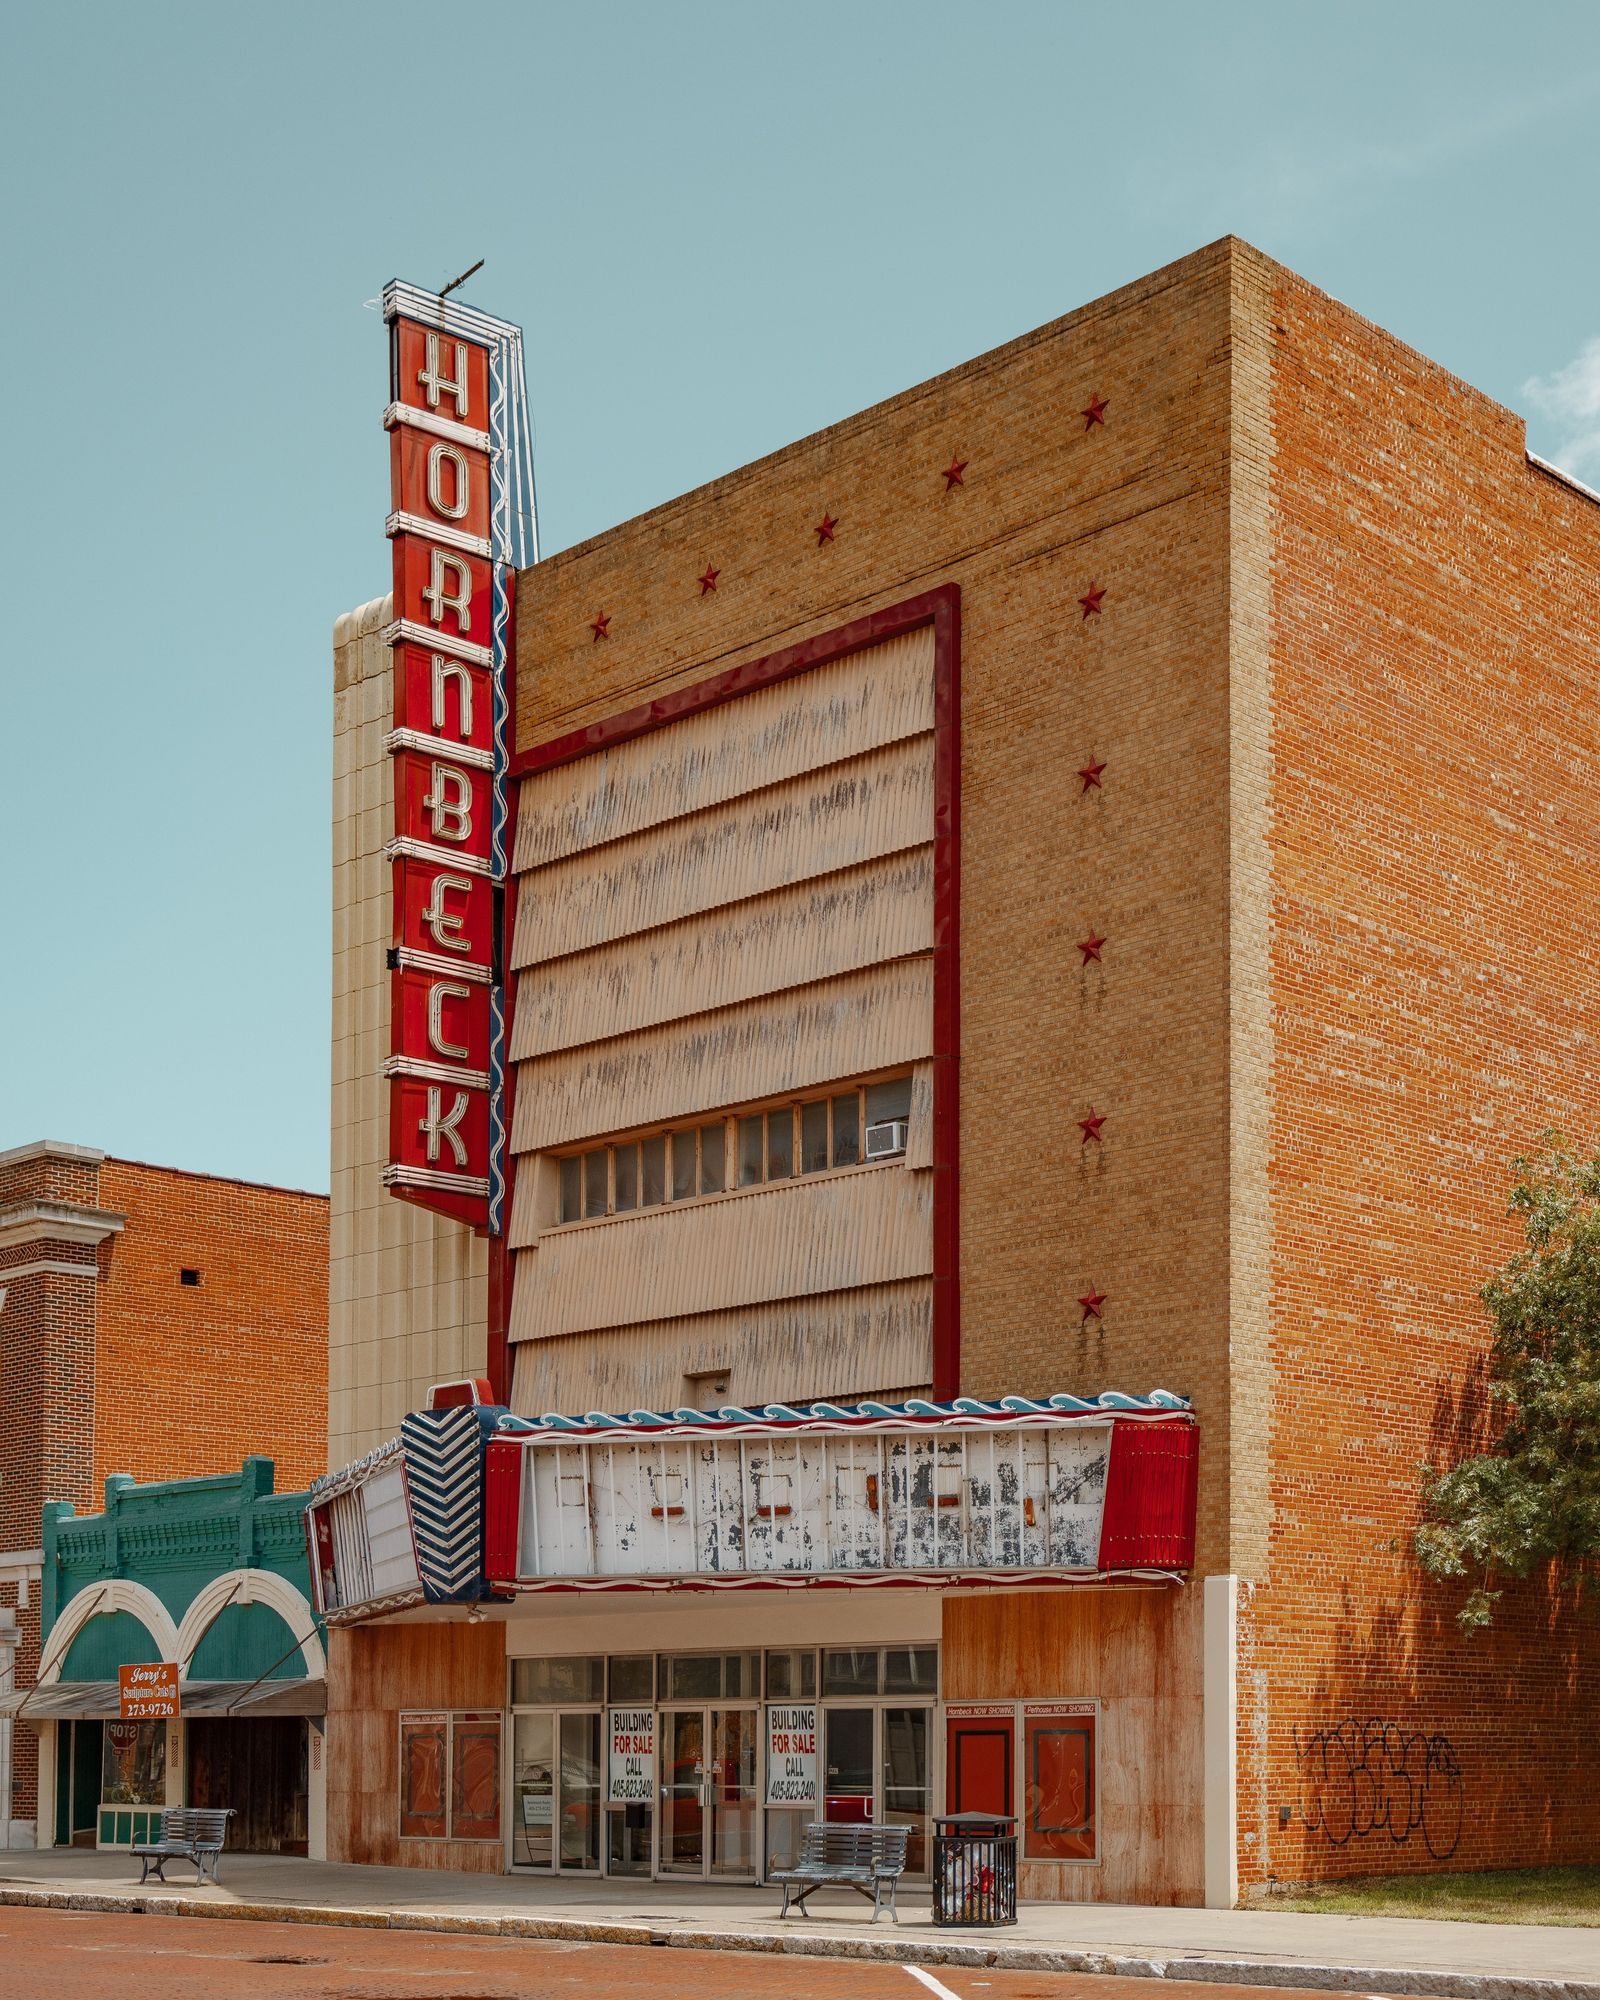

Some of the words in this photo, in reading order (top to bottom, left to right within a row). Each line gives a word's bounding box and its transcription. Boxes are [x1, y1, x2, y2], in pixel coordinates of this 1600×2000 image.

[131, 1667, 167, 1684] Jerry's
[123, 1687, 153, 1701] Sculpture
[128, 1703, 173, 1716] 273-9726
[974, 1706, 988, 1714] NOW
[988, 1706, 1014, 1714] SHOWING
[1053, 1705, 1067, 1713] NOW
[1068, 1704, 1094, 1713] SHOWING
[614, 1713, 653, 1732] BUILDING
[771, 1710, 815, 1730] BUILDING
[614, 1735, 631, 1754] FOR
[633, 1735, 653, 1754] SALE
[772, 1734, 790, 1754] FOR
[792, 1734, 816, 1754] SALE
[625, 1757, 642, 1776] CALL
[785, 1757, 804, 1777] CALL
